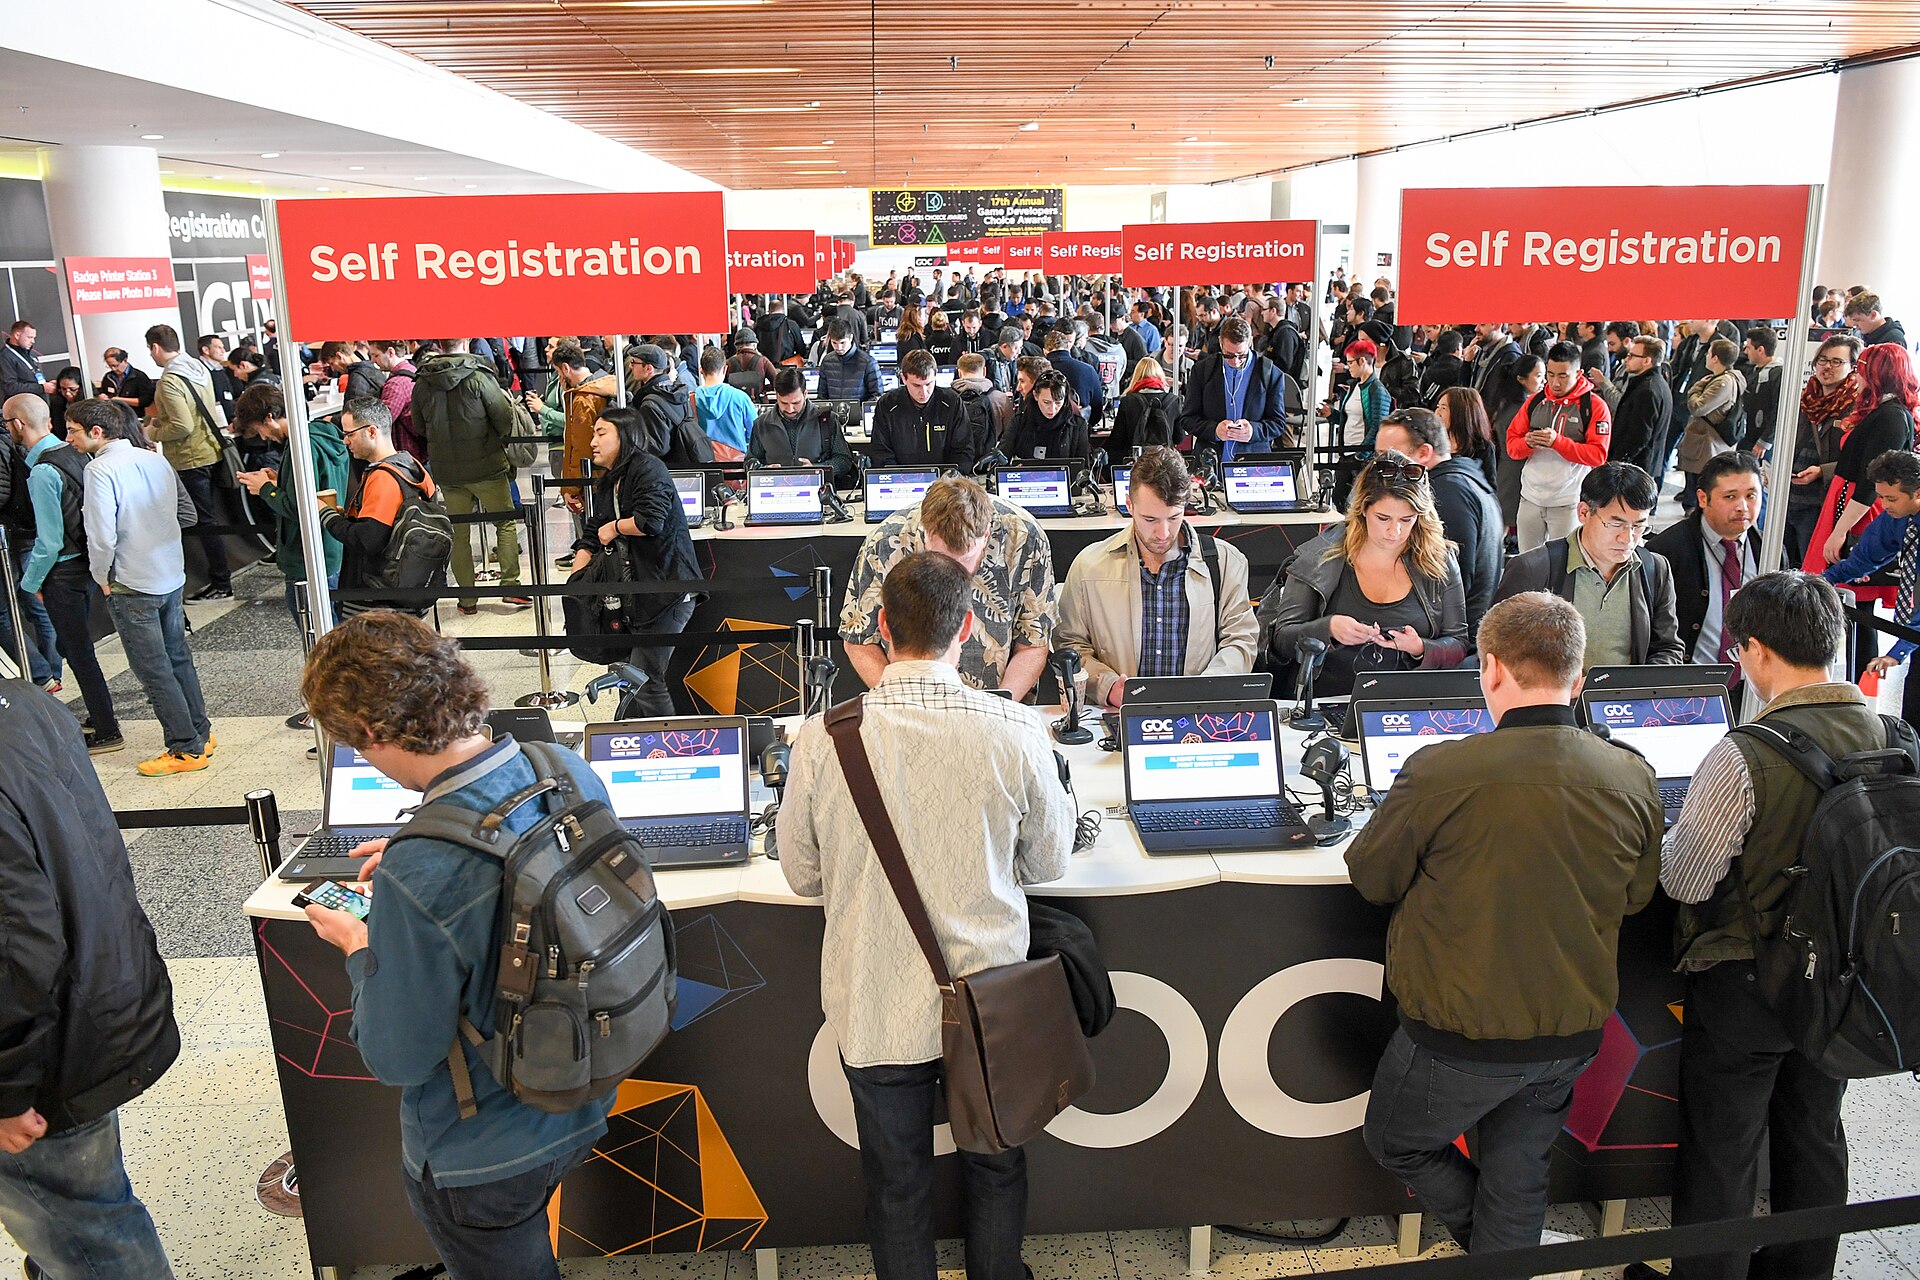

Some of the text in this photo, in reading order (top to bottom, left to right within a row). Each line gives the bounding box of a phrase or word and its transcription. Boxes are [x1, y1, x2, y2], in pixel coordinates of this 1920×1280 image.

[990, 196, 1044, 206] 17th Annual
[874, 214, 890, 222] GAME
[946, 213, 968, 221] AWARDS
[977, 206, 1058, 217] Game Developers
[983, 215, 1053, 225] Choice Awards
[963, 247, 979, 255] Self
[982, 246, 1001, 255] Self
[1009, 246, 1031, 257] Self
[1050, 244, 1078, 258] Self
[1133, 239, 1305, 263] Self Registration
[1424, 227, 1782, 273] Self Registration
[310, 237, 701, 286] Self Registration
[915, 258, 933, 266] GDC
[72, 269, 158, 285] Badge Printer Station 3
[76, 285, 172, 301] Please have Photo ID ready
[1603, 704, 1634, 717] GDC
[1140, 718, 1174, 733] GDC
[1381, 713, 1411, 726] GDC
[609, 736, 641, 749] GDC
